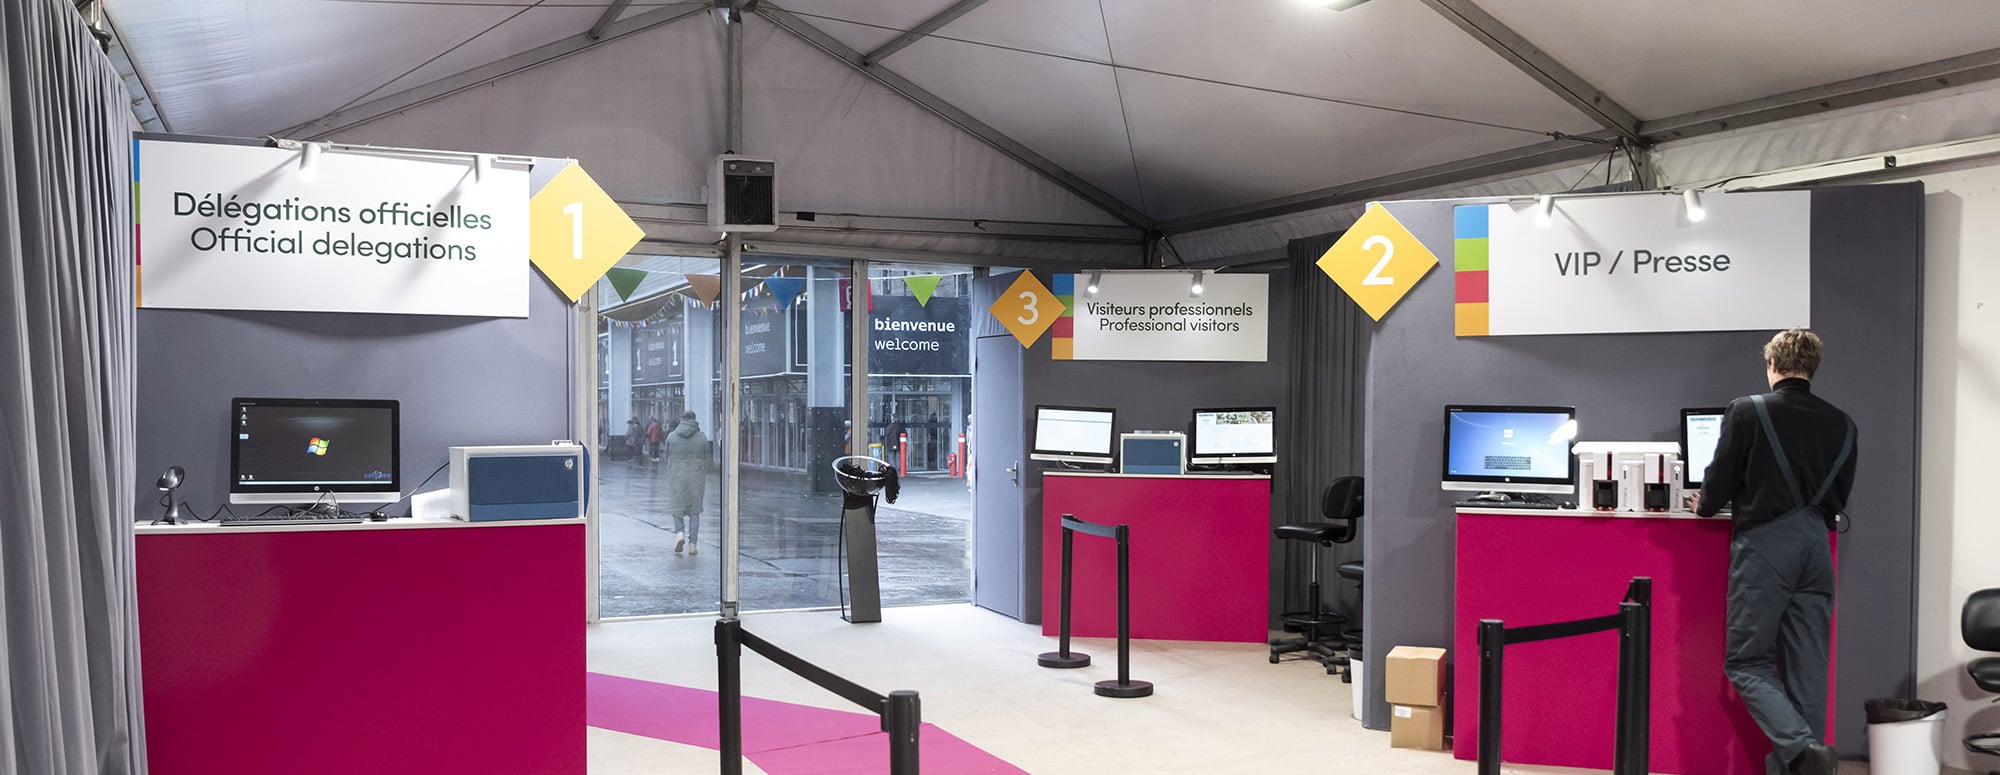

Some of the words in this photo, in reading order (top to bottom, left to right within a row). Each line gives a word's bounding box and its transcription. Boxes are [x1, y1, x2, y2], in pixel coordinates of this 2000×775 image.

[173, 191, 351, 226] Délégations
[359, 202, 492, 231] officielles
[190, 226, 303, 254] Official
[312, 231, 477, 264] delegations
[562, 201, 583, 260] 1
[1361, 235, 1395, 286] 2
[1554, 251, 1601, 276] VIP
[1608, 250, 1624, 275] /
[1634, 249, 1731, 274] Presse
[1017, 291, 1039, 326] 3
[1086, 302, 1146, 316] Visiteurs
[1149, 302, 1253, 319] professionnels
[874, 317, 956, 333] bienvenue
[1099, 318, 1186, 332] Professional
[1189, 318, 1240, 332] visitors
[874, 338, 940, 352] welcome
